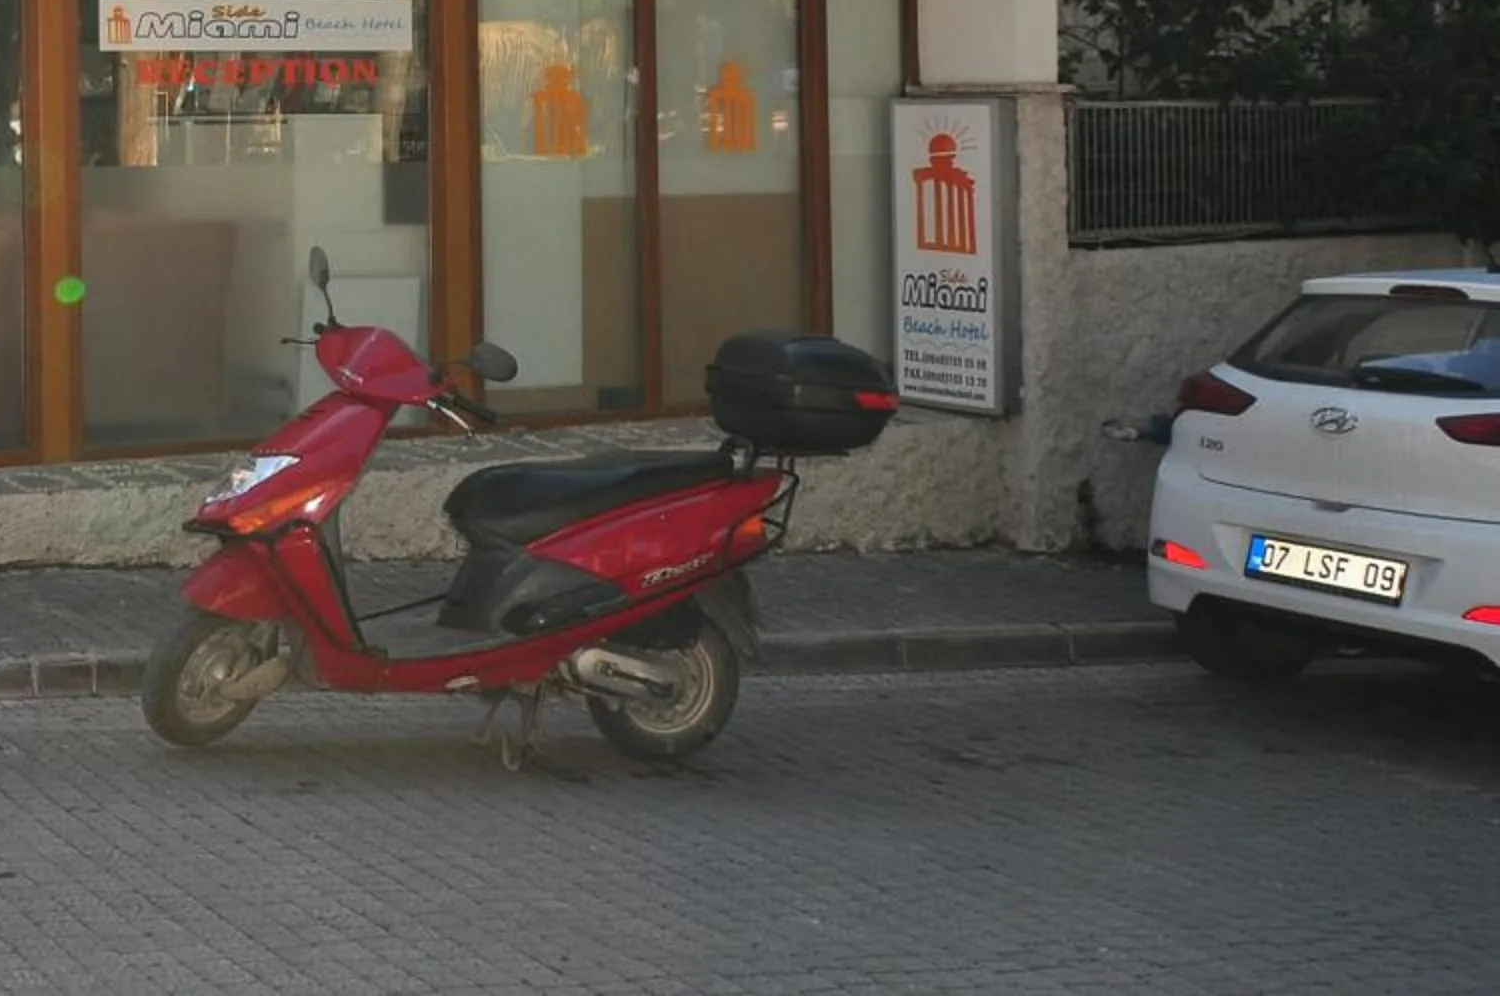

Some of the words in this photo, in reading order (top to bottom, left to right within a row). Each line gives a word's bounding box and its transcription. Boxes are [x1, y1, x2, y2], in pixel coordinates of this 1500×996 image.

[135, 11, 300, 39] Miami
[304, 18, 358, 31] Beach
[361, 17, 405, 30] Hotel
[211, 5, 267, 20] Side
[135, 59, 379, 87] RECEPTION
[940, 268, 967, 283] Side
[902, 271, 989, 314] Miami
[903, 316, 947, 335] Beach
[949, 318, 989, 341] Hotel
[1261, 543, 1291, 571] 07
[1303, 550, 1349, 582] LSF
[1362, 562, 1397, 592] 09
